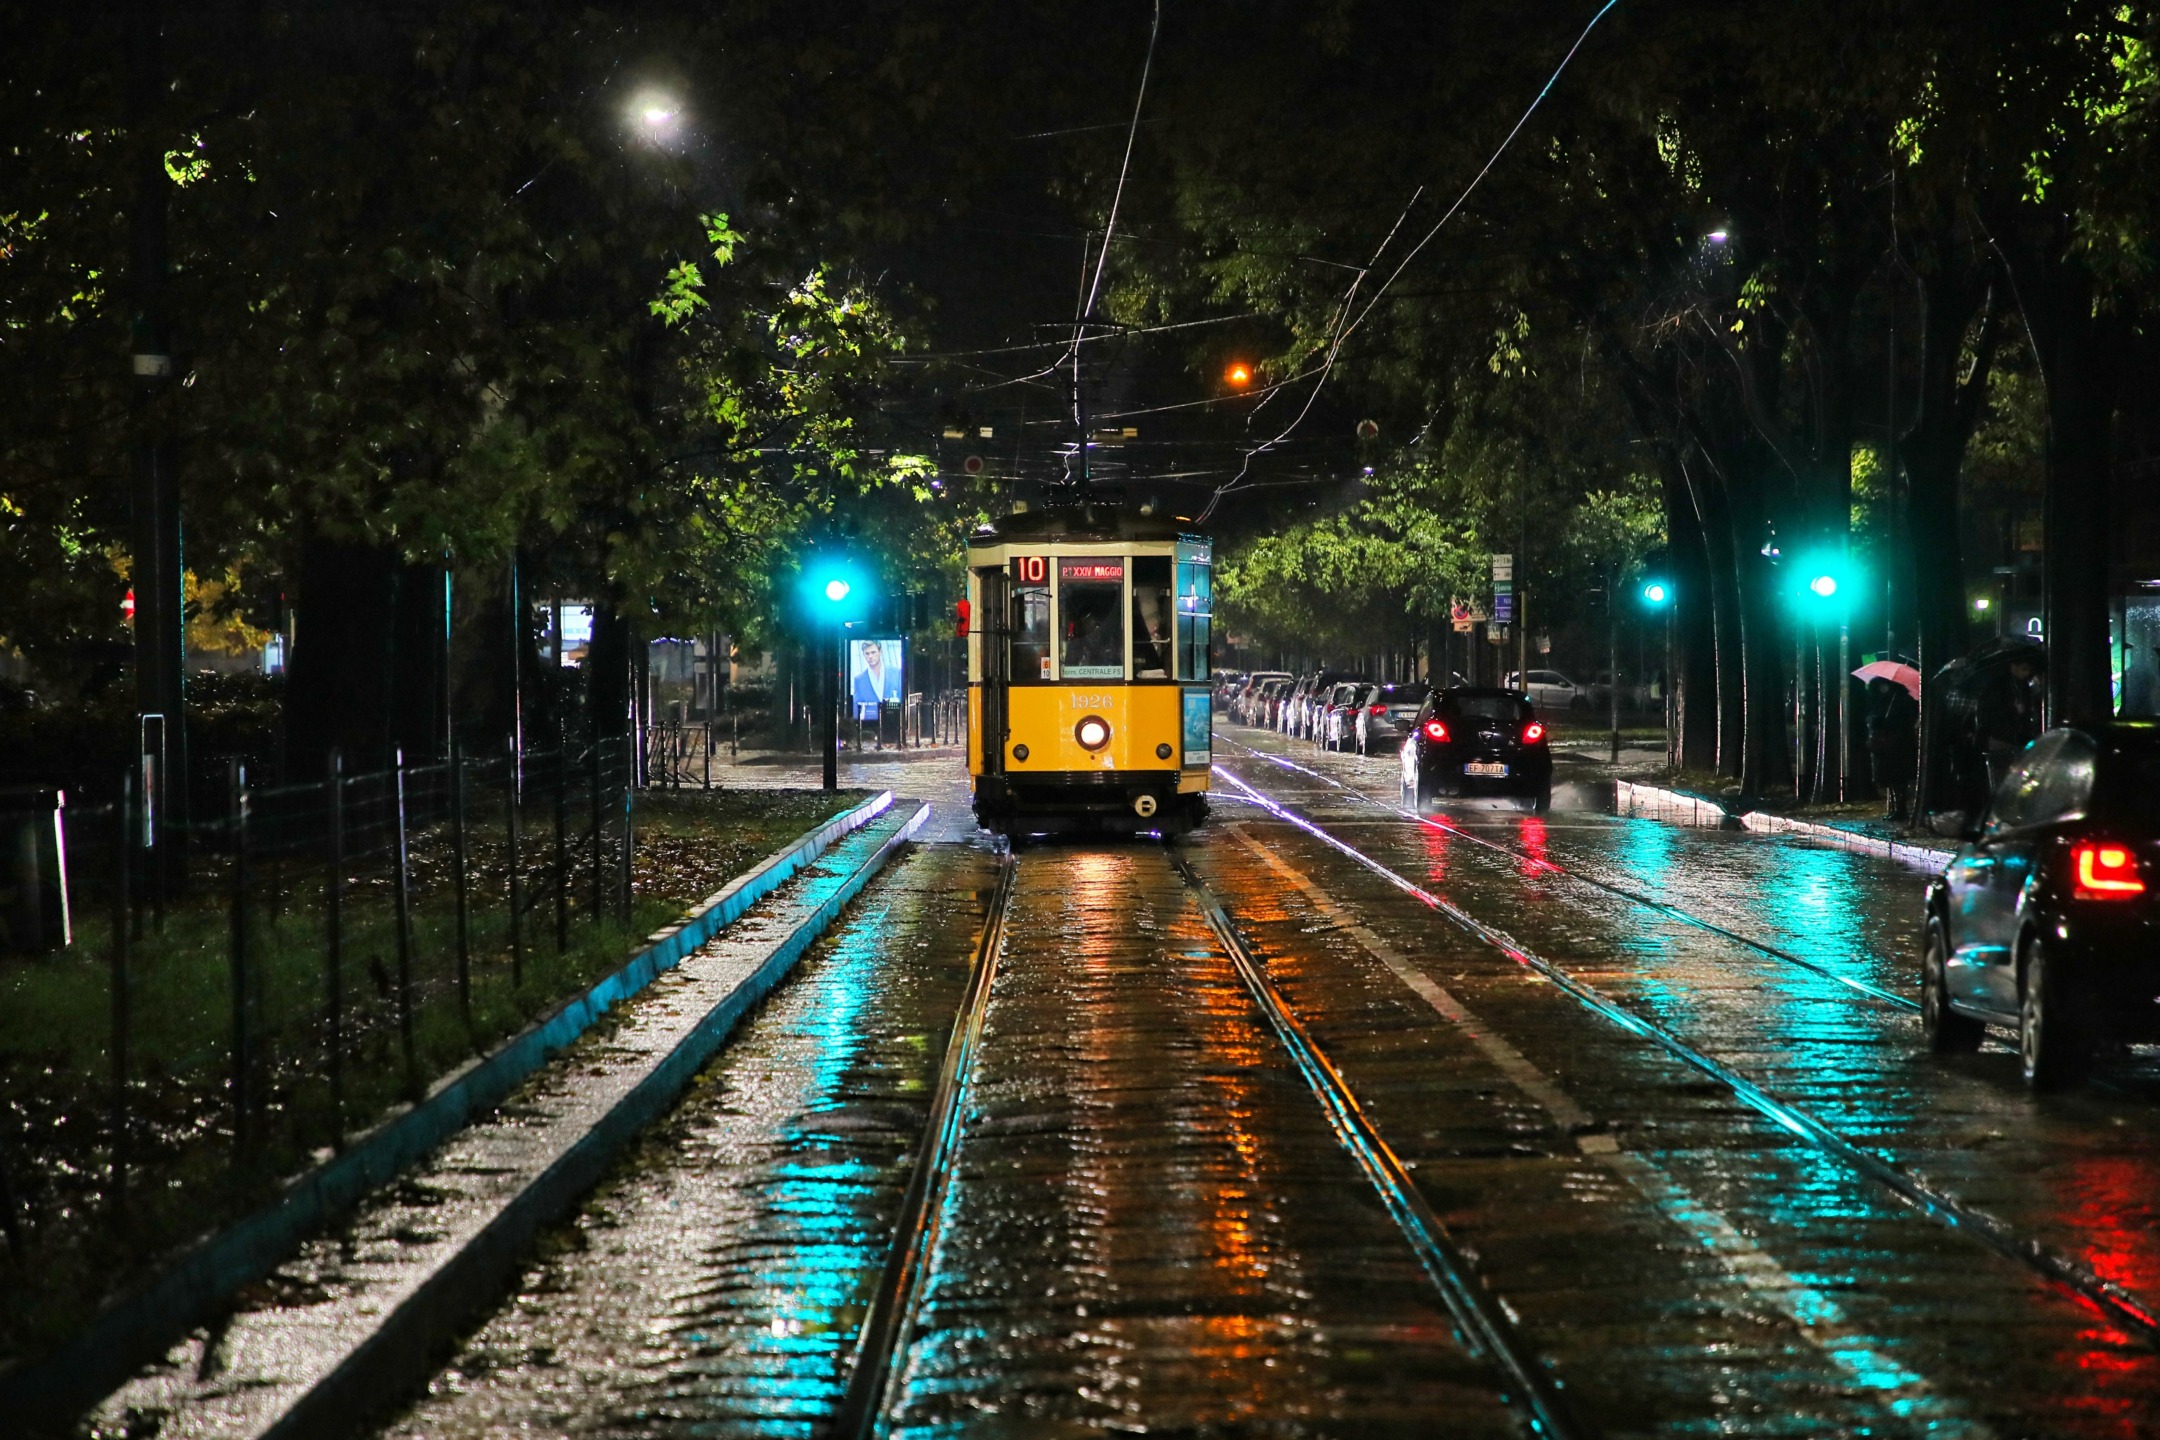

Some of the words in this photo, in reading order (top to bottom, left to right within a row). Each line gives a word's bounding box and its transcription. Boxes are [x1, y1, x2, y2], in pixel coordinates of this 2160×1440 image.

[1018, 556, 1043, 582] 10
[1073, 566, 1092, 577] XXIV
[1094, 566, 1122, 577] MAGGIO
[1071, 694, 1113, 709] 1926
